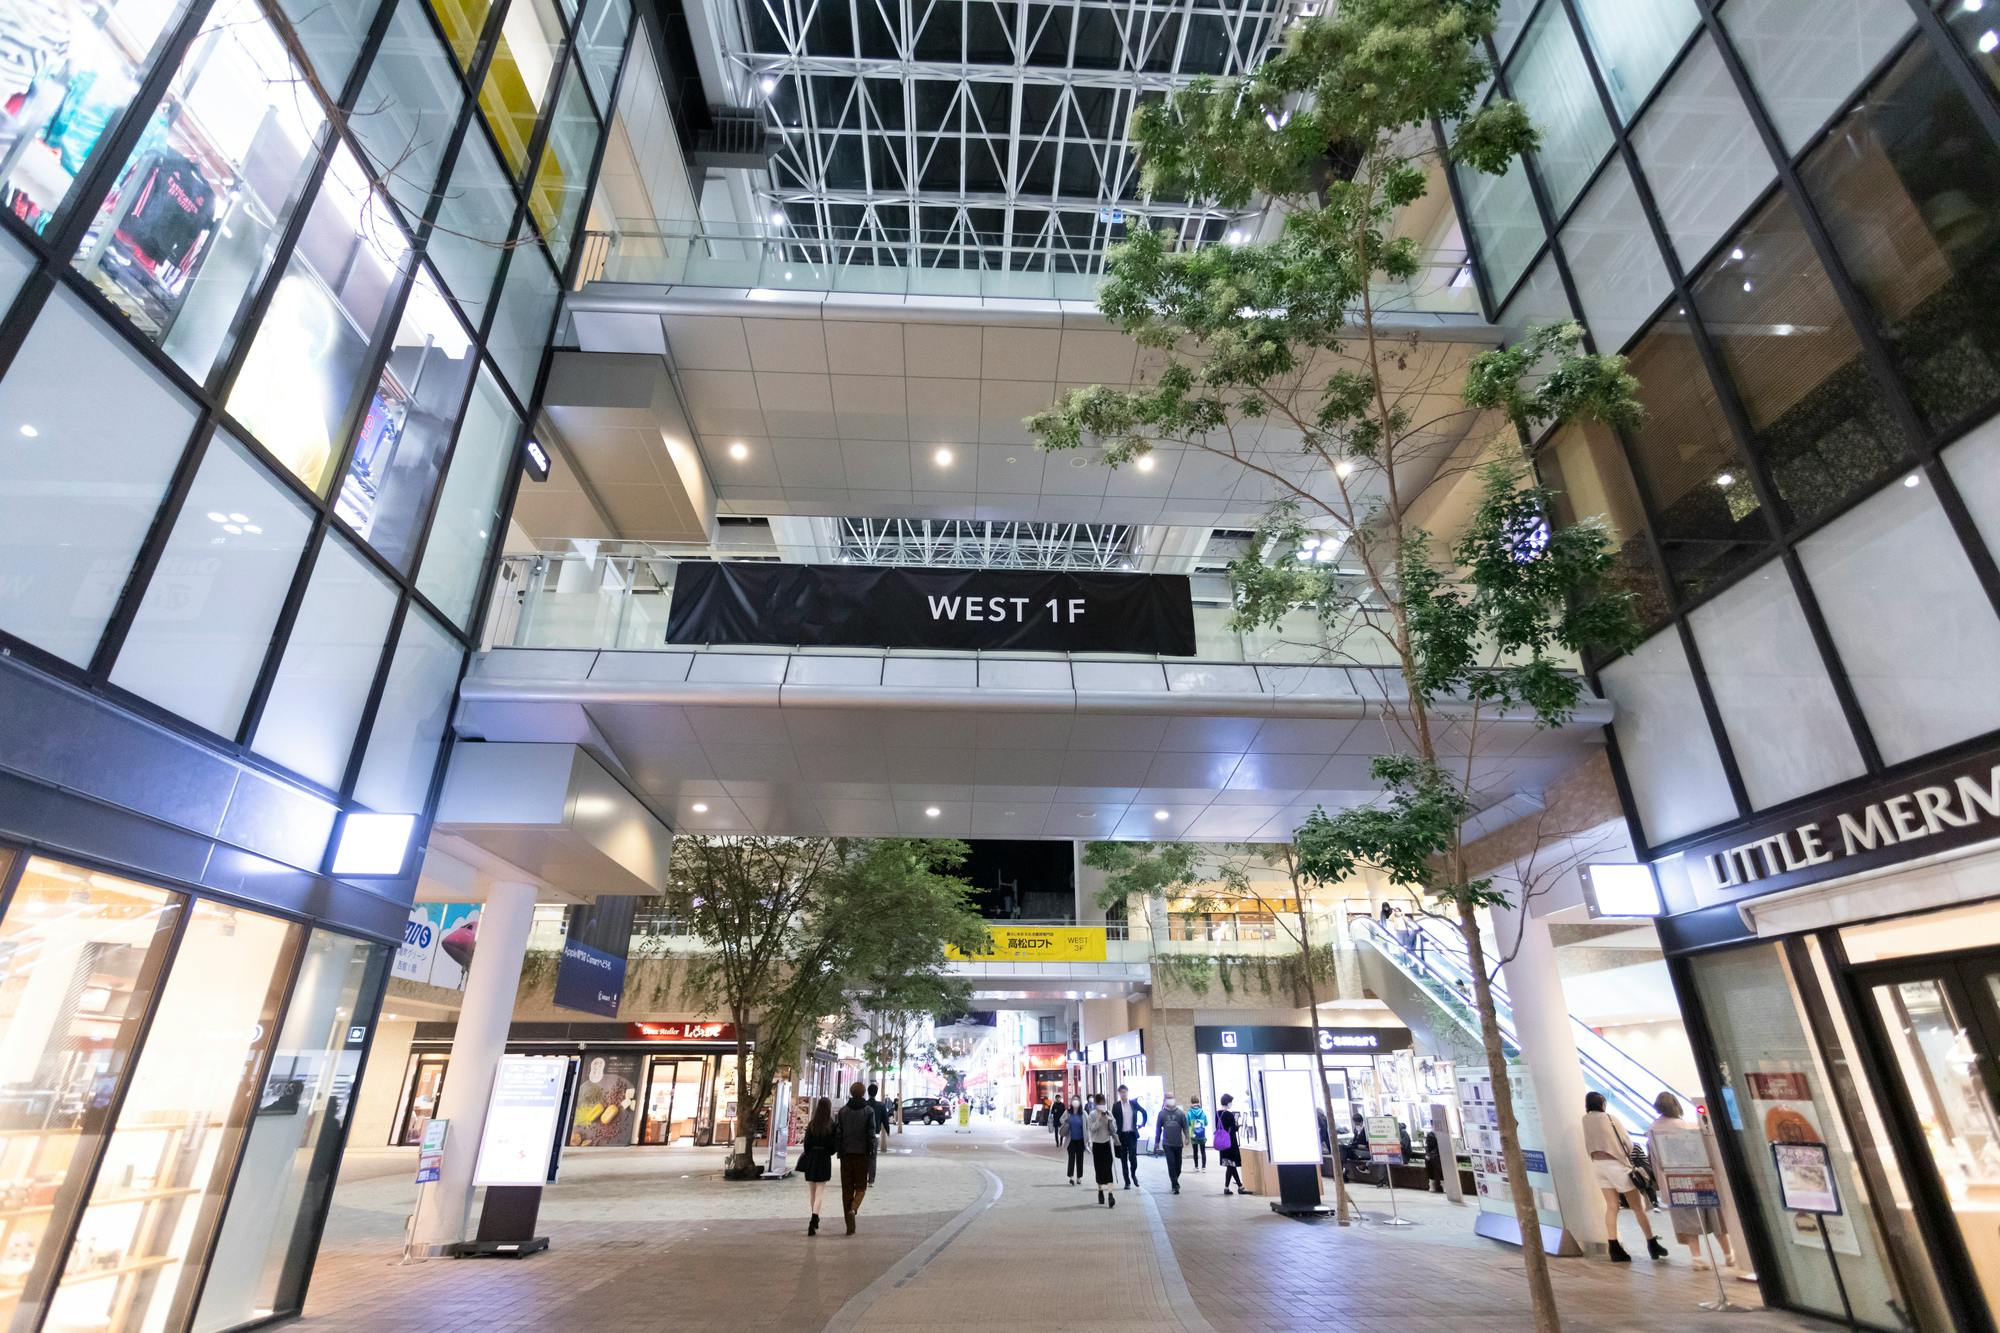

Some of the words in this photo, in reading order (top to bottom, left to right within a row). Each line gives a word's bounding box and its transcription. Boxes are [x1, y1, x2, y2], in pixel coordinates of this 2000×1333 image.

[928, 595, 1030, 623] WEST
[1044, 598, 1086, 624] 1F
[1704, 822, 1834, 890] LITTLE
[1007, 938, 1053, 949] 高松ロフト
[1067, 936, 1089, 944] WEST
[1074, 944, 1084, 952] 3F
[1333, 1036, 1377, 1046] smart
